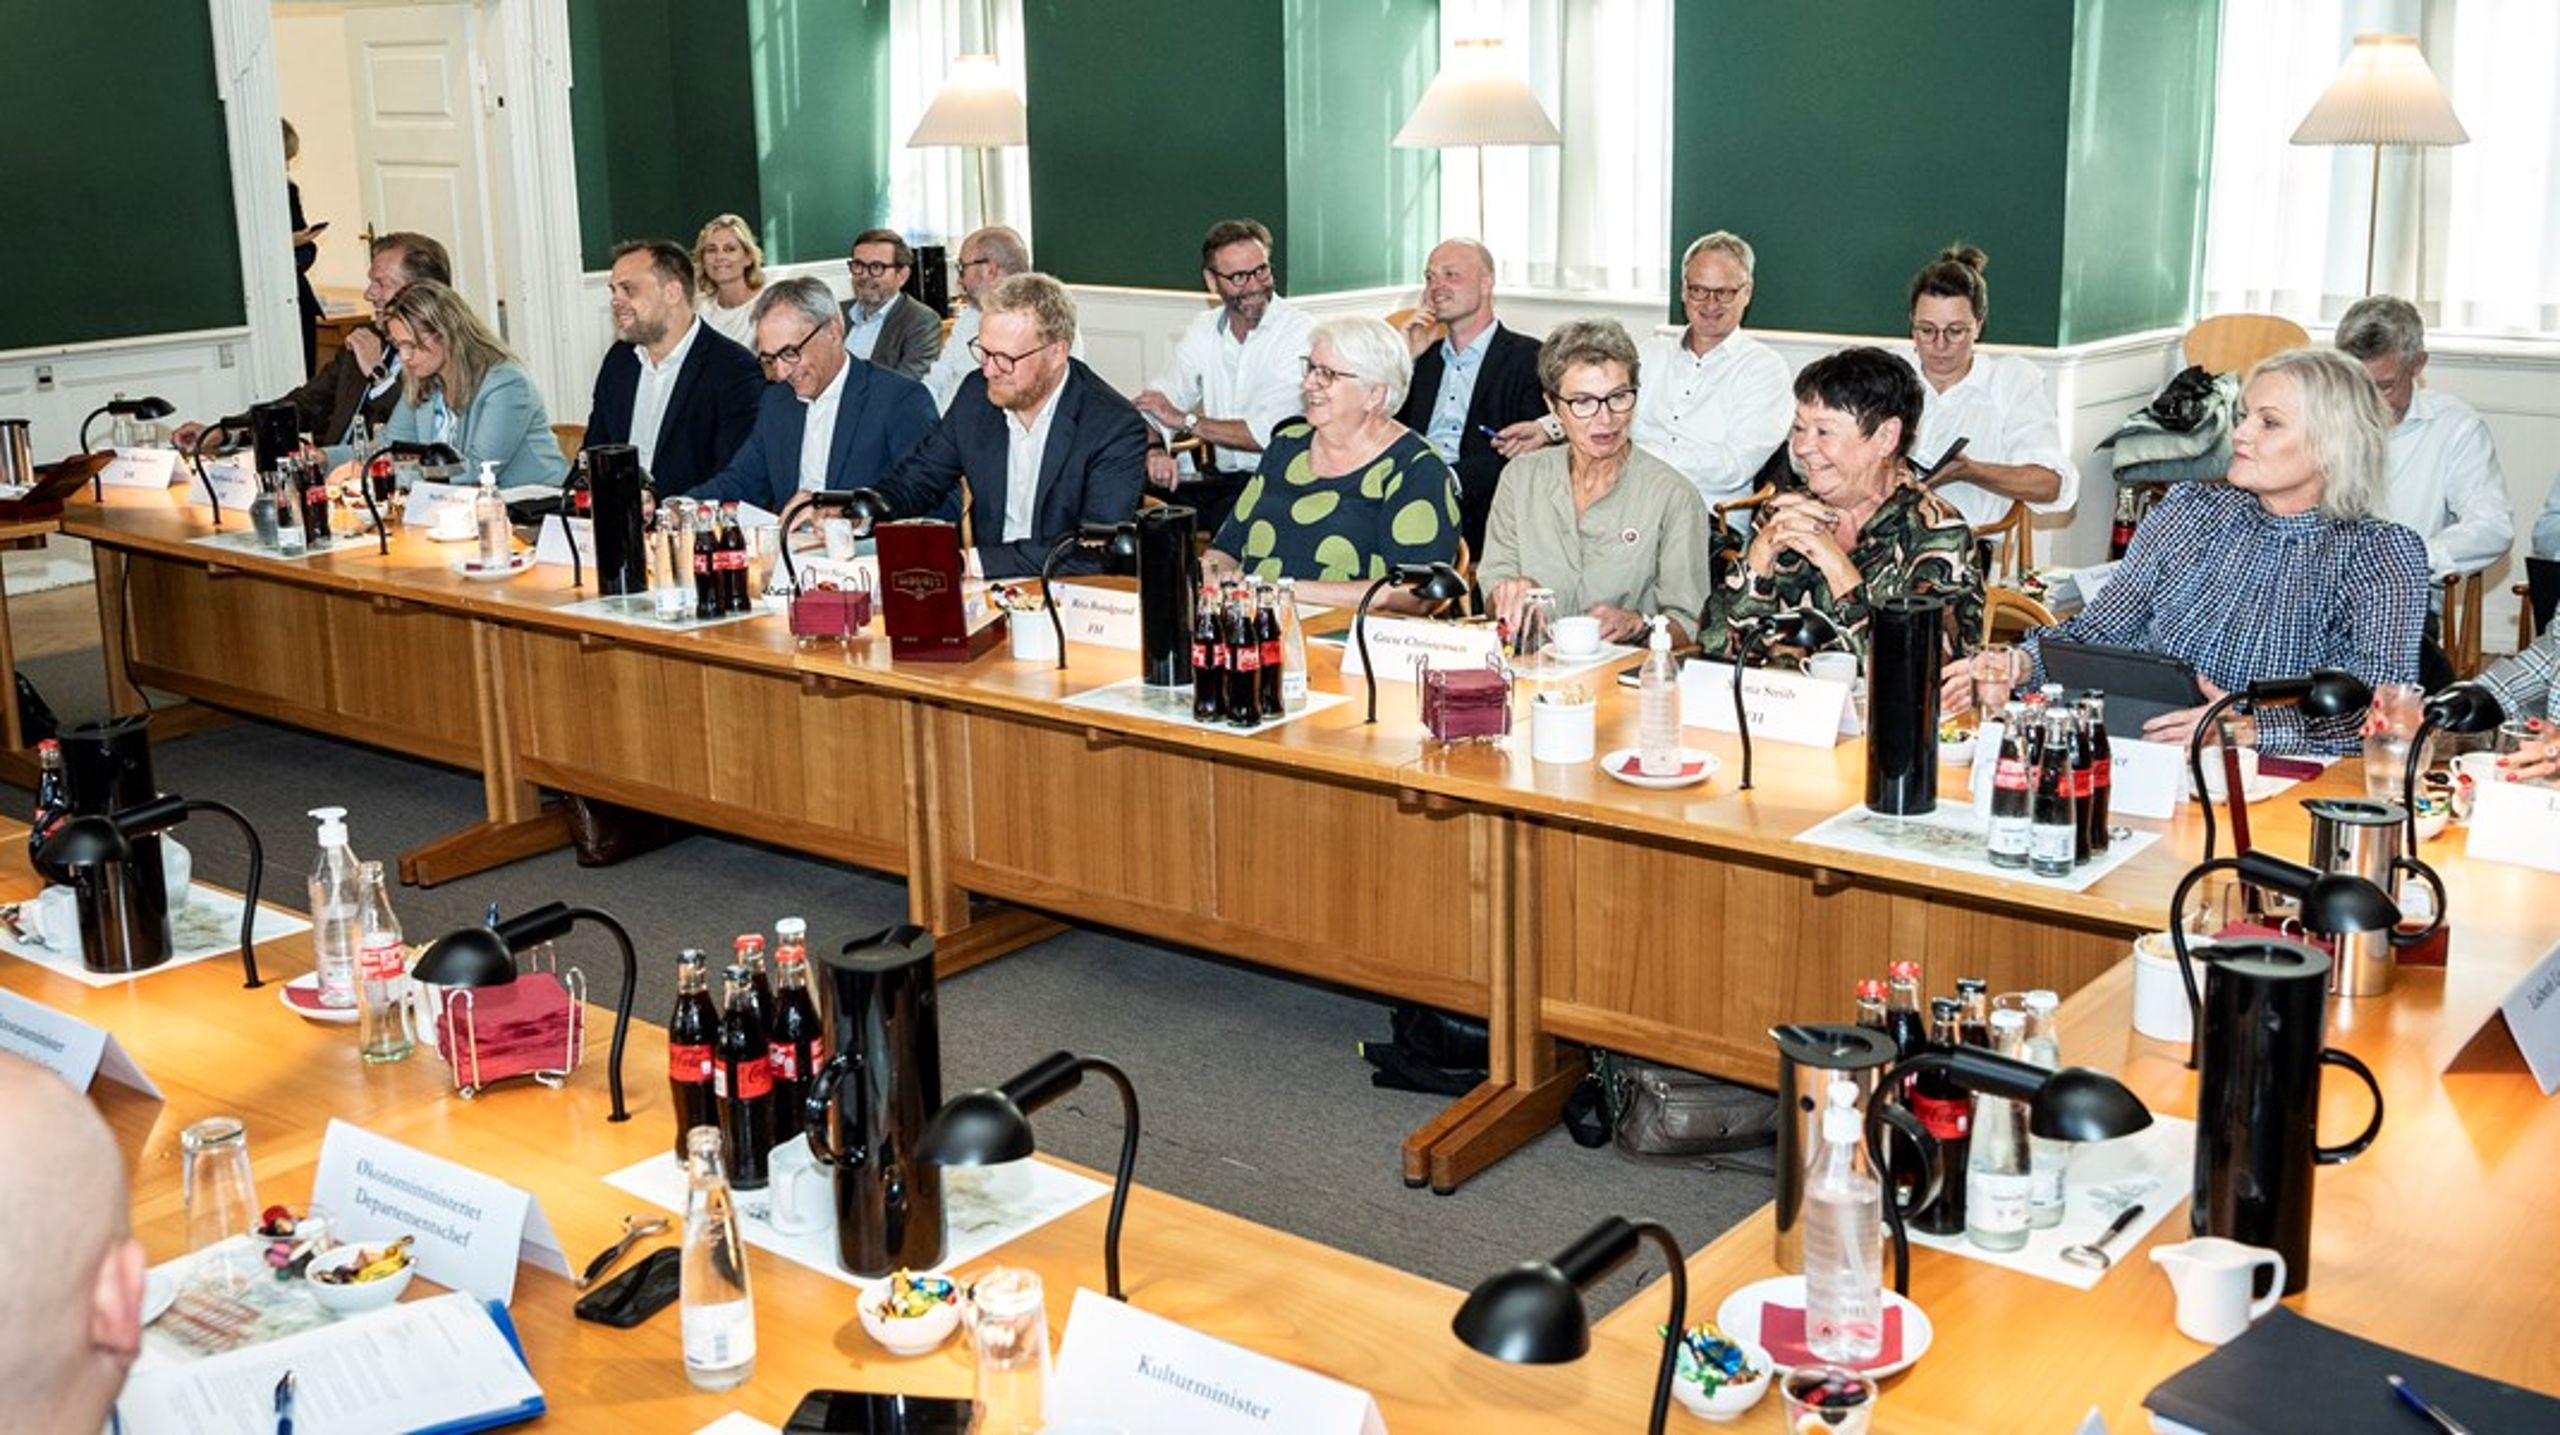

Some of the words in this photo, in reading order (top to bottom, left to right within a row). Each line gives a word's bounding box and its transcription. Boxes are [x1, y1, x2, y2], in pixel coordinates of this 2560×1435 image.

[356, 1157, 482, 1221] Økonomiministeriet
[356, 1186, 472, 1247] Departementschef
[1138, 1353, 1271, 1421] Kulturminister
